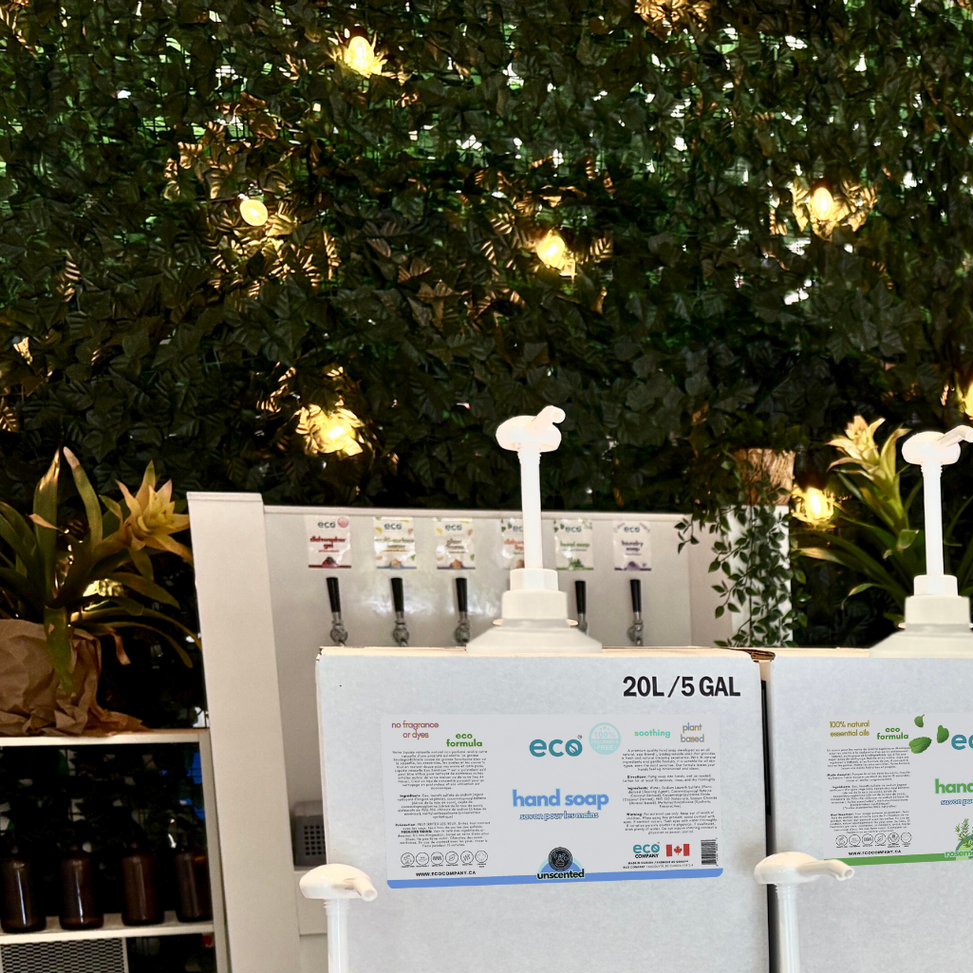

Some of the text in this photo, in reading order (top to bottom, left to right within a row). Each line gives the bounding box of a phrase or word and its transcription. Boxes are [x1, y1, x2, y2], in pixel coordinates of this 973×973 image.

[317, 521, 336, 529] eco
[698, 675, 741, 698] GAL
[391, 719, 440, 732] no fragrance
[682, 722, 704, 734] plant
[847, 720, 870, 728] natural
[402, 728, 430, 741] or dyes
[594, 730, 617, 740] 100%
[634, 728, 671, 740] soothing
[680, 733, 705, 744] based
[877, 732, 910, 741] formula
[446, 738, 483, 748] formula
[529, 737, 583, 758] eco
[596, 744, 615, 752] FREE
[512, 788, 610, 811] hand soap
[632, 843, 661, 855] eco
[537, 868, 585, 880] unscented
